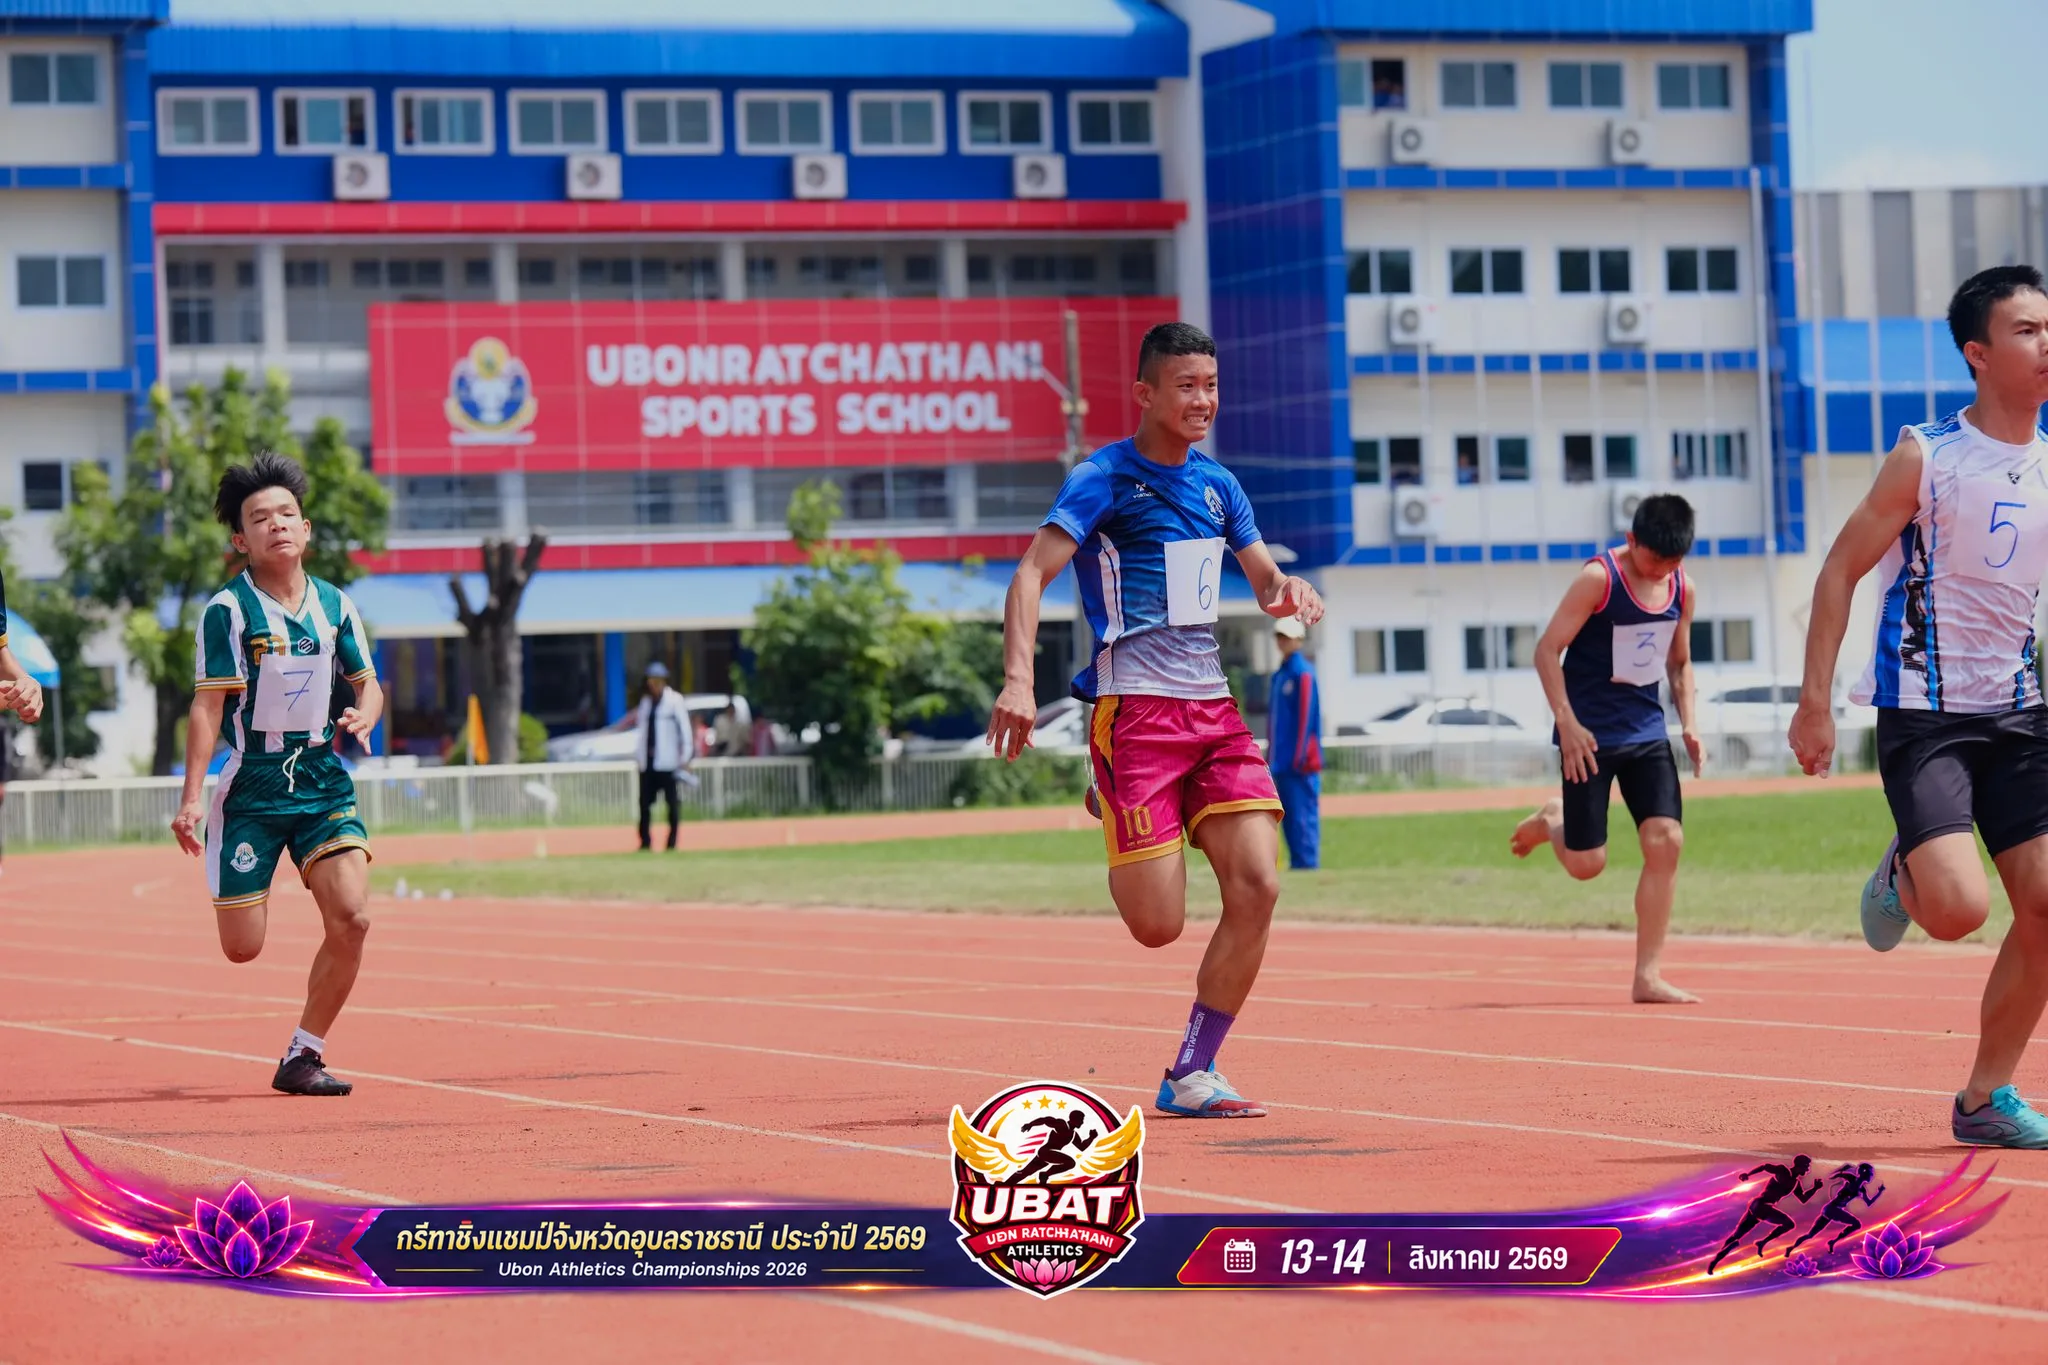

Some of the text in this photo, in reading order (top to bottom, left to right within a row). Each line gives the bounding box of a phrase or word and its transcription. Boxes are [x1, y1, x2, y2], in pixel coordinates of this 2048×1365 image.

[587, 341, 1044, 386] UBONRATCHATHANI
[641, 391, 1011, 437] SPORTS SCHOOL
[1984, 501, 2026, 568] 5
[1198, 557, 1213, 610] 6
[1633, 632, 1657, 667] 3
[282, 670, 314, 712] 7
[1122, 806, 1152, 838] 10
